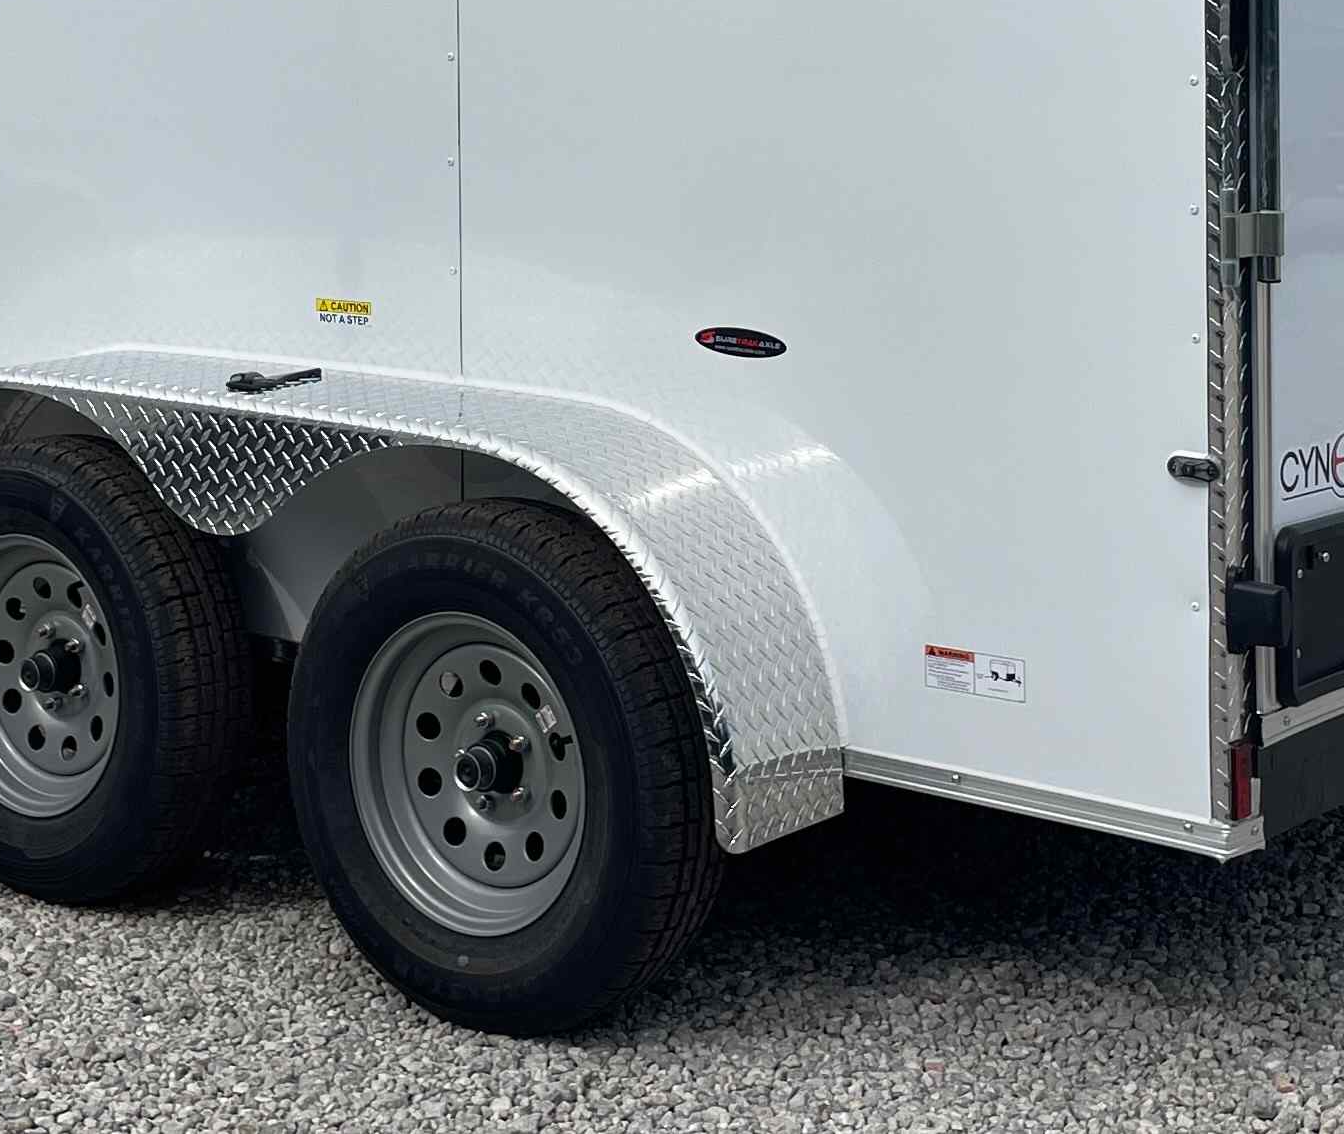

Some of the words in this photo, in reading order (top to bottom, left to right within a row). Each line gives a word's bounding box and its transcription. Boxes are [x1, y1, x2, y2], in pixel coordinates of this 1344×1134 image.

[330, 301, 369, 313] CAUTION
[319, 313, 337, 323] NOT
[339, 315, 345, 323] A
[347, 315, 369, 325] STEP
